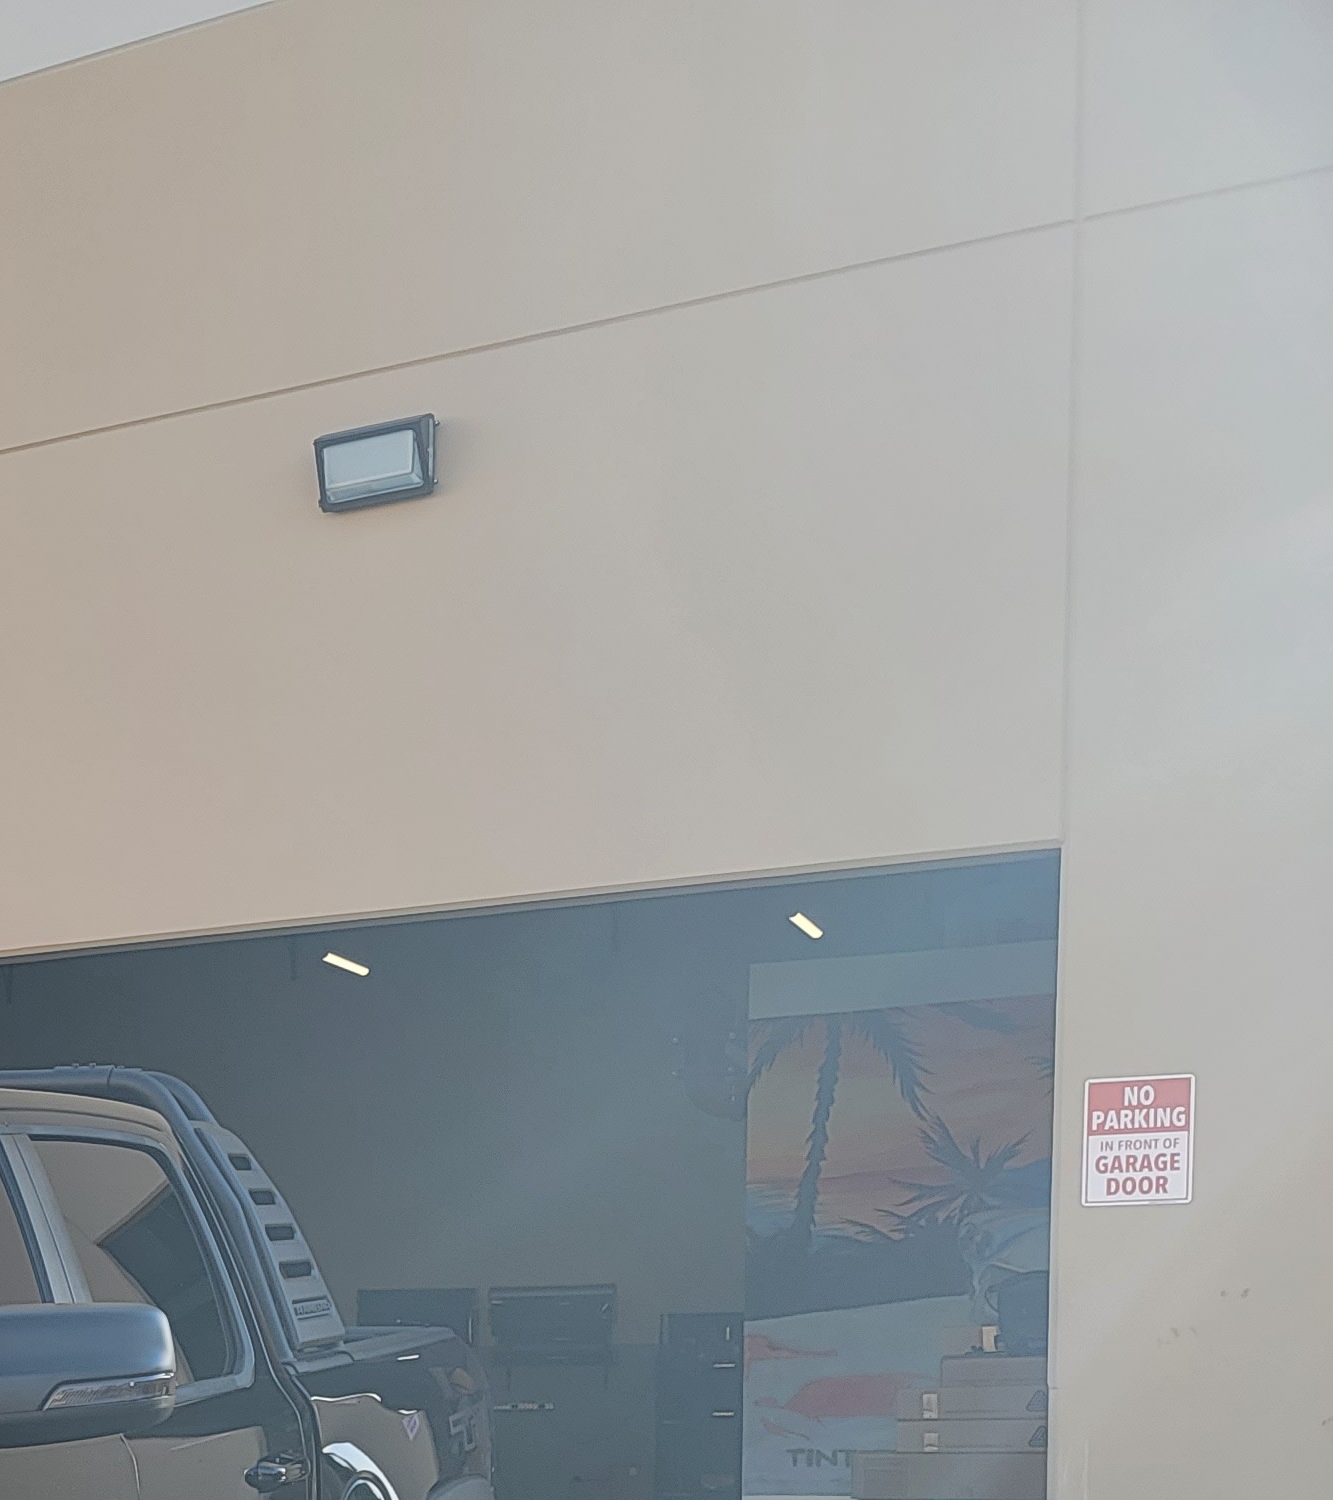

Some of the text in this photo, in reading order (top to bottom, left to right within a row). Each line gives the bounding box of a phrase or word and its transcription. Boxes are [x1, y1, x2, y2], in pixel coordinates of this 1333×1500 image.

[1124, 1085, 1155, 1107] NO
[1091, 1106, 1186, 1131] PARKING
[1100, 1137, 1180, 1152] IN FRONT OF
[1095, 1152, 1181, 1174] GARAGE
[1106, 1175, 1168, 1196] DOOR
[786, 1448, 856, 1467] TINT
